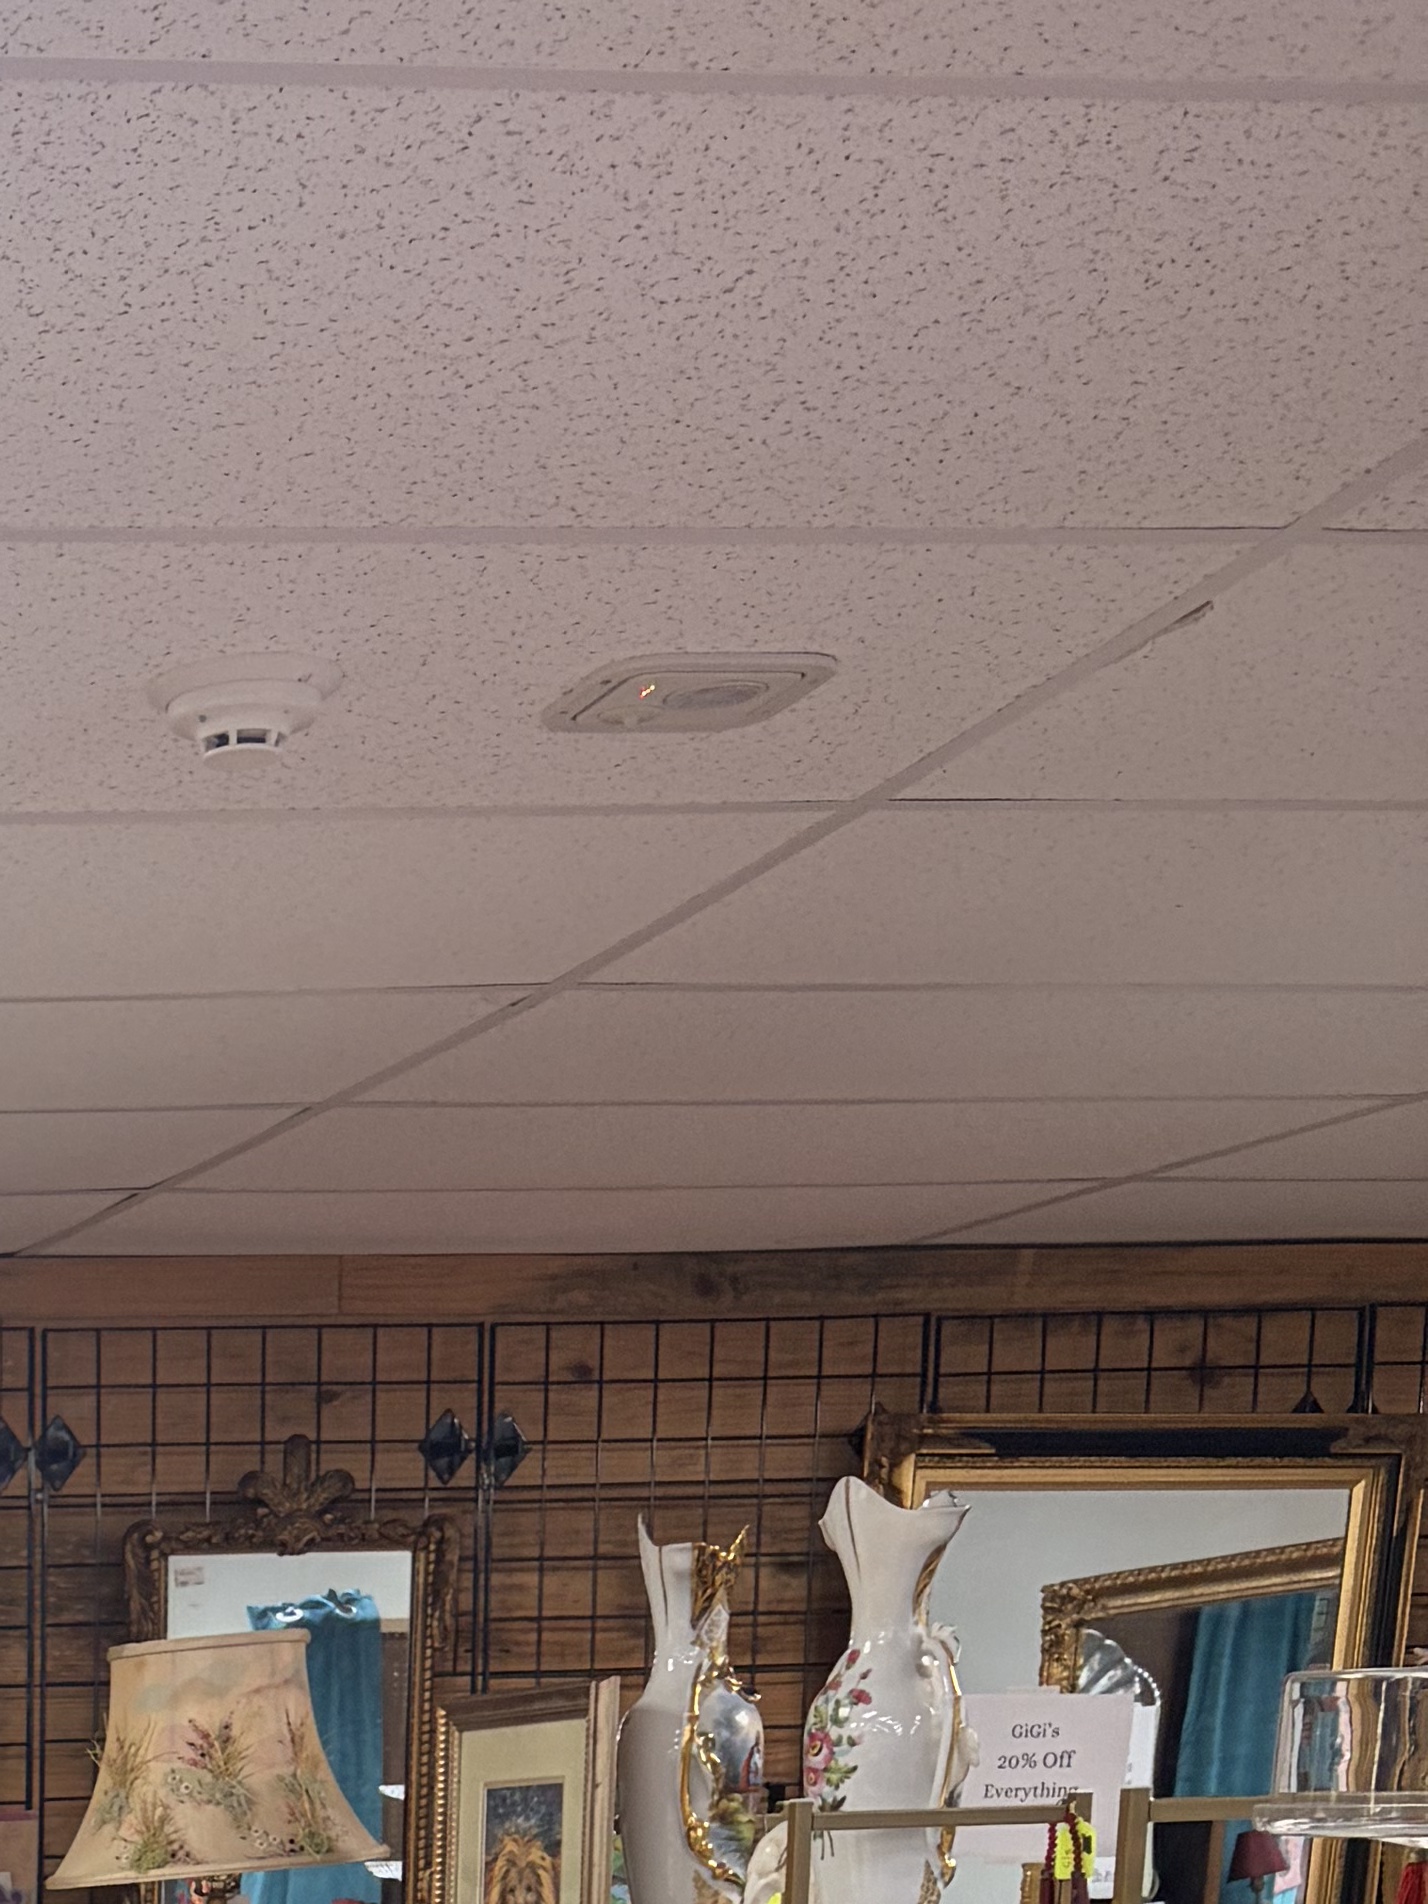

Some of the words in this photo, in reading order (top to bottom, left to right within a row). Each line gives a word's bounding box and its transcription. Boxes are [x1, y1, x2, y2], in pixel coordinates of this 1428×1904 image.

[1011, 1722, 1060, 1739] GiGi's
[997, 1752, 1037, 1770] 20%
[1043, 1750, 1076, 1768] Off
